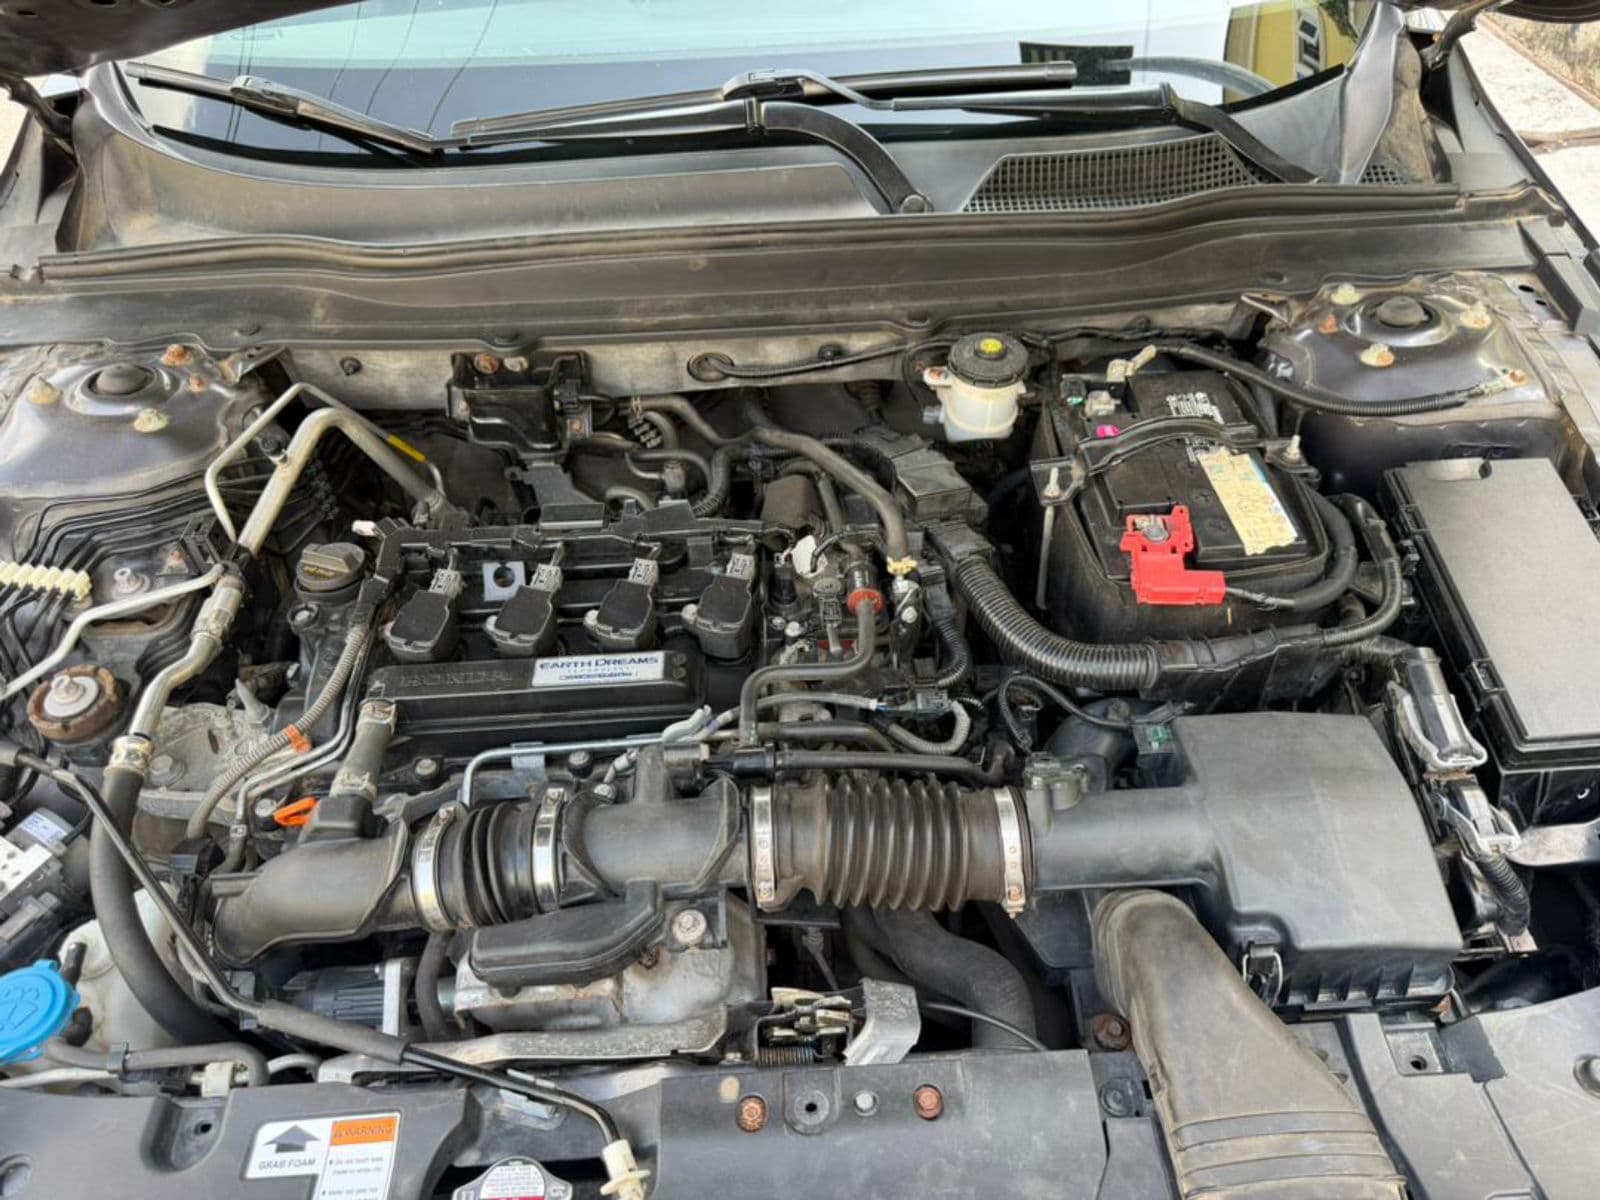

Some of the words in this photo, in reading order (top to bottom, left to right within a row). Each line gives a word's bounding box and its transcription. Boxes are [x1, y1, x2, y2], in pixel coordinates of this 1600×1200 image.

[540, 660, 592, 670] EARTH
[595, 656, 659, 667] DREAMS
[258, 1159, 287, 1171] GRAB
[288, 1157, 317, 1169] FOAM
